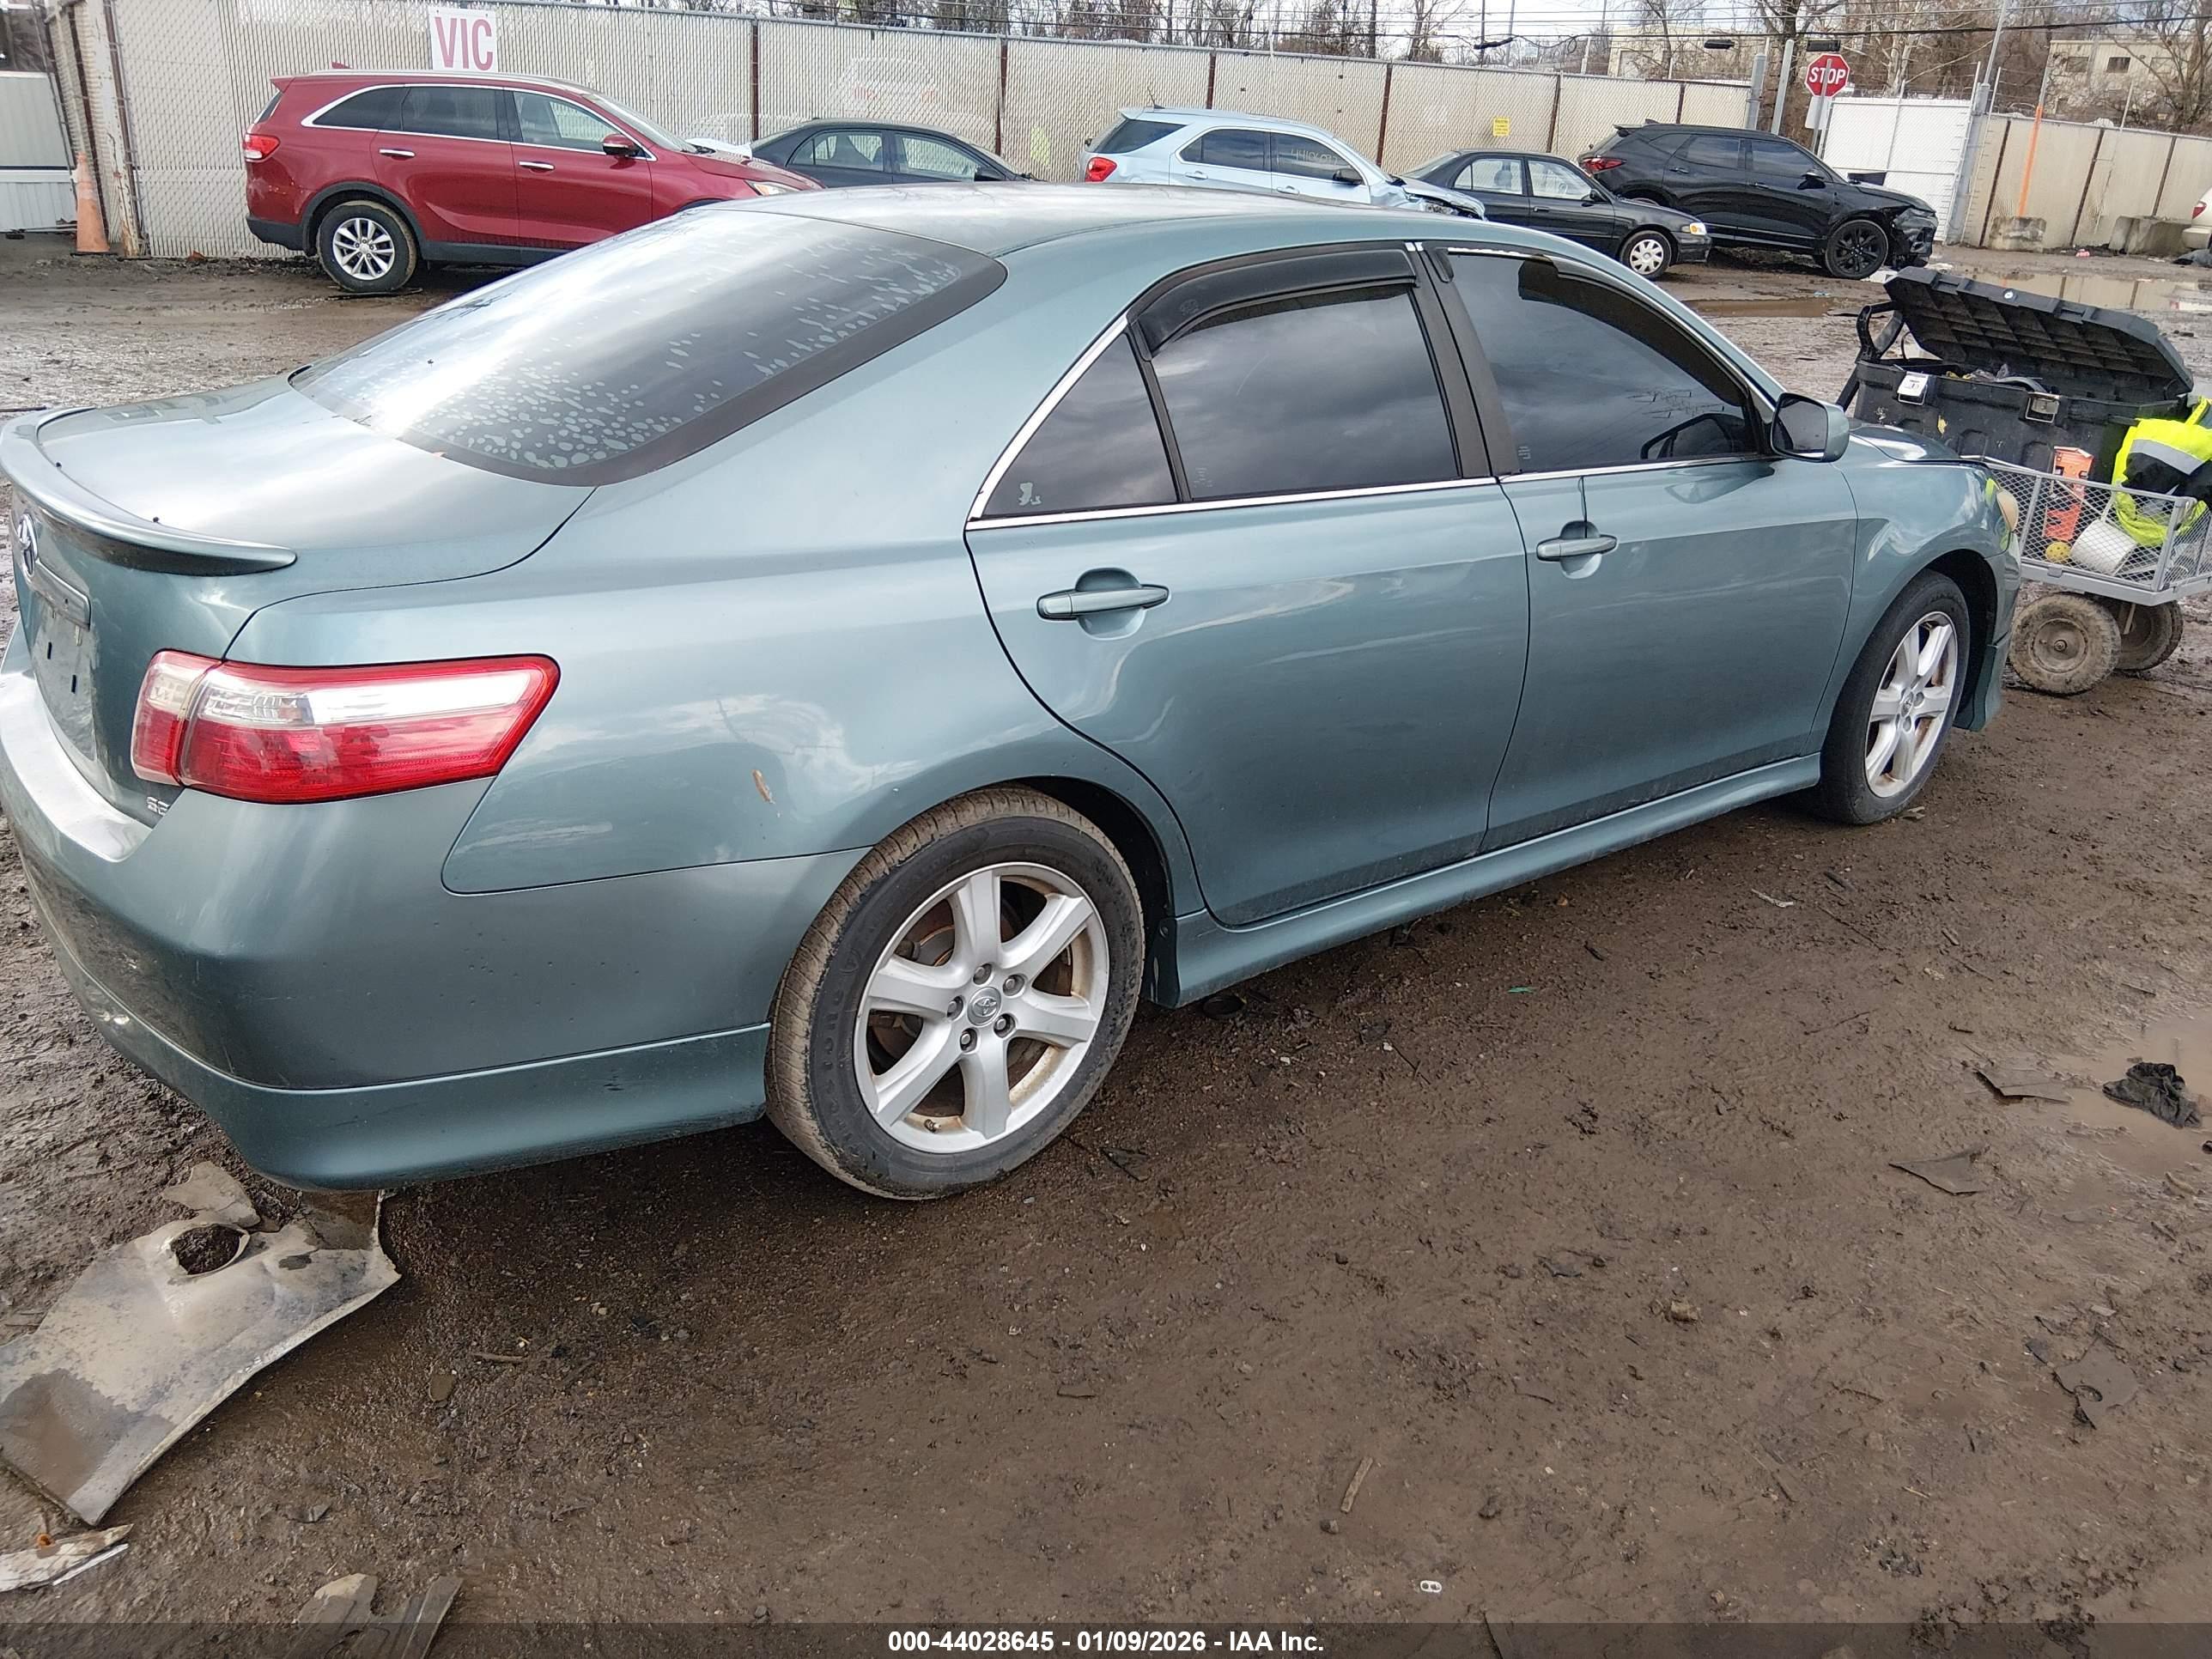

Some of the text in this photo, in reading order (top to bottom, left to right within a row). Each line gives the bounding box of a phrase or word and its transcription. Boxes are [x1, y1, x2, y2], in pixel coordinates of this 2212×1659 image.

[434, 16, 494, 71] VIC
[1808, 66, 1846, 85] STOP
[146, 796, 170, 816] SE
